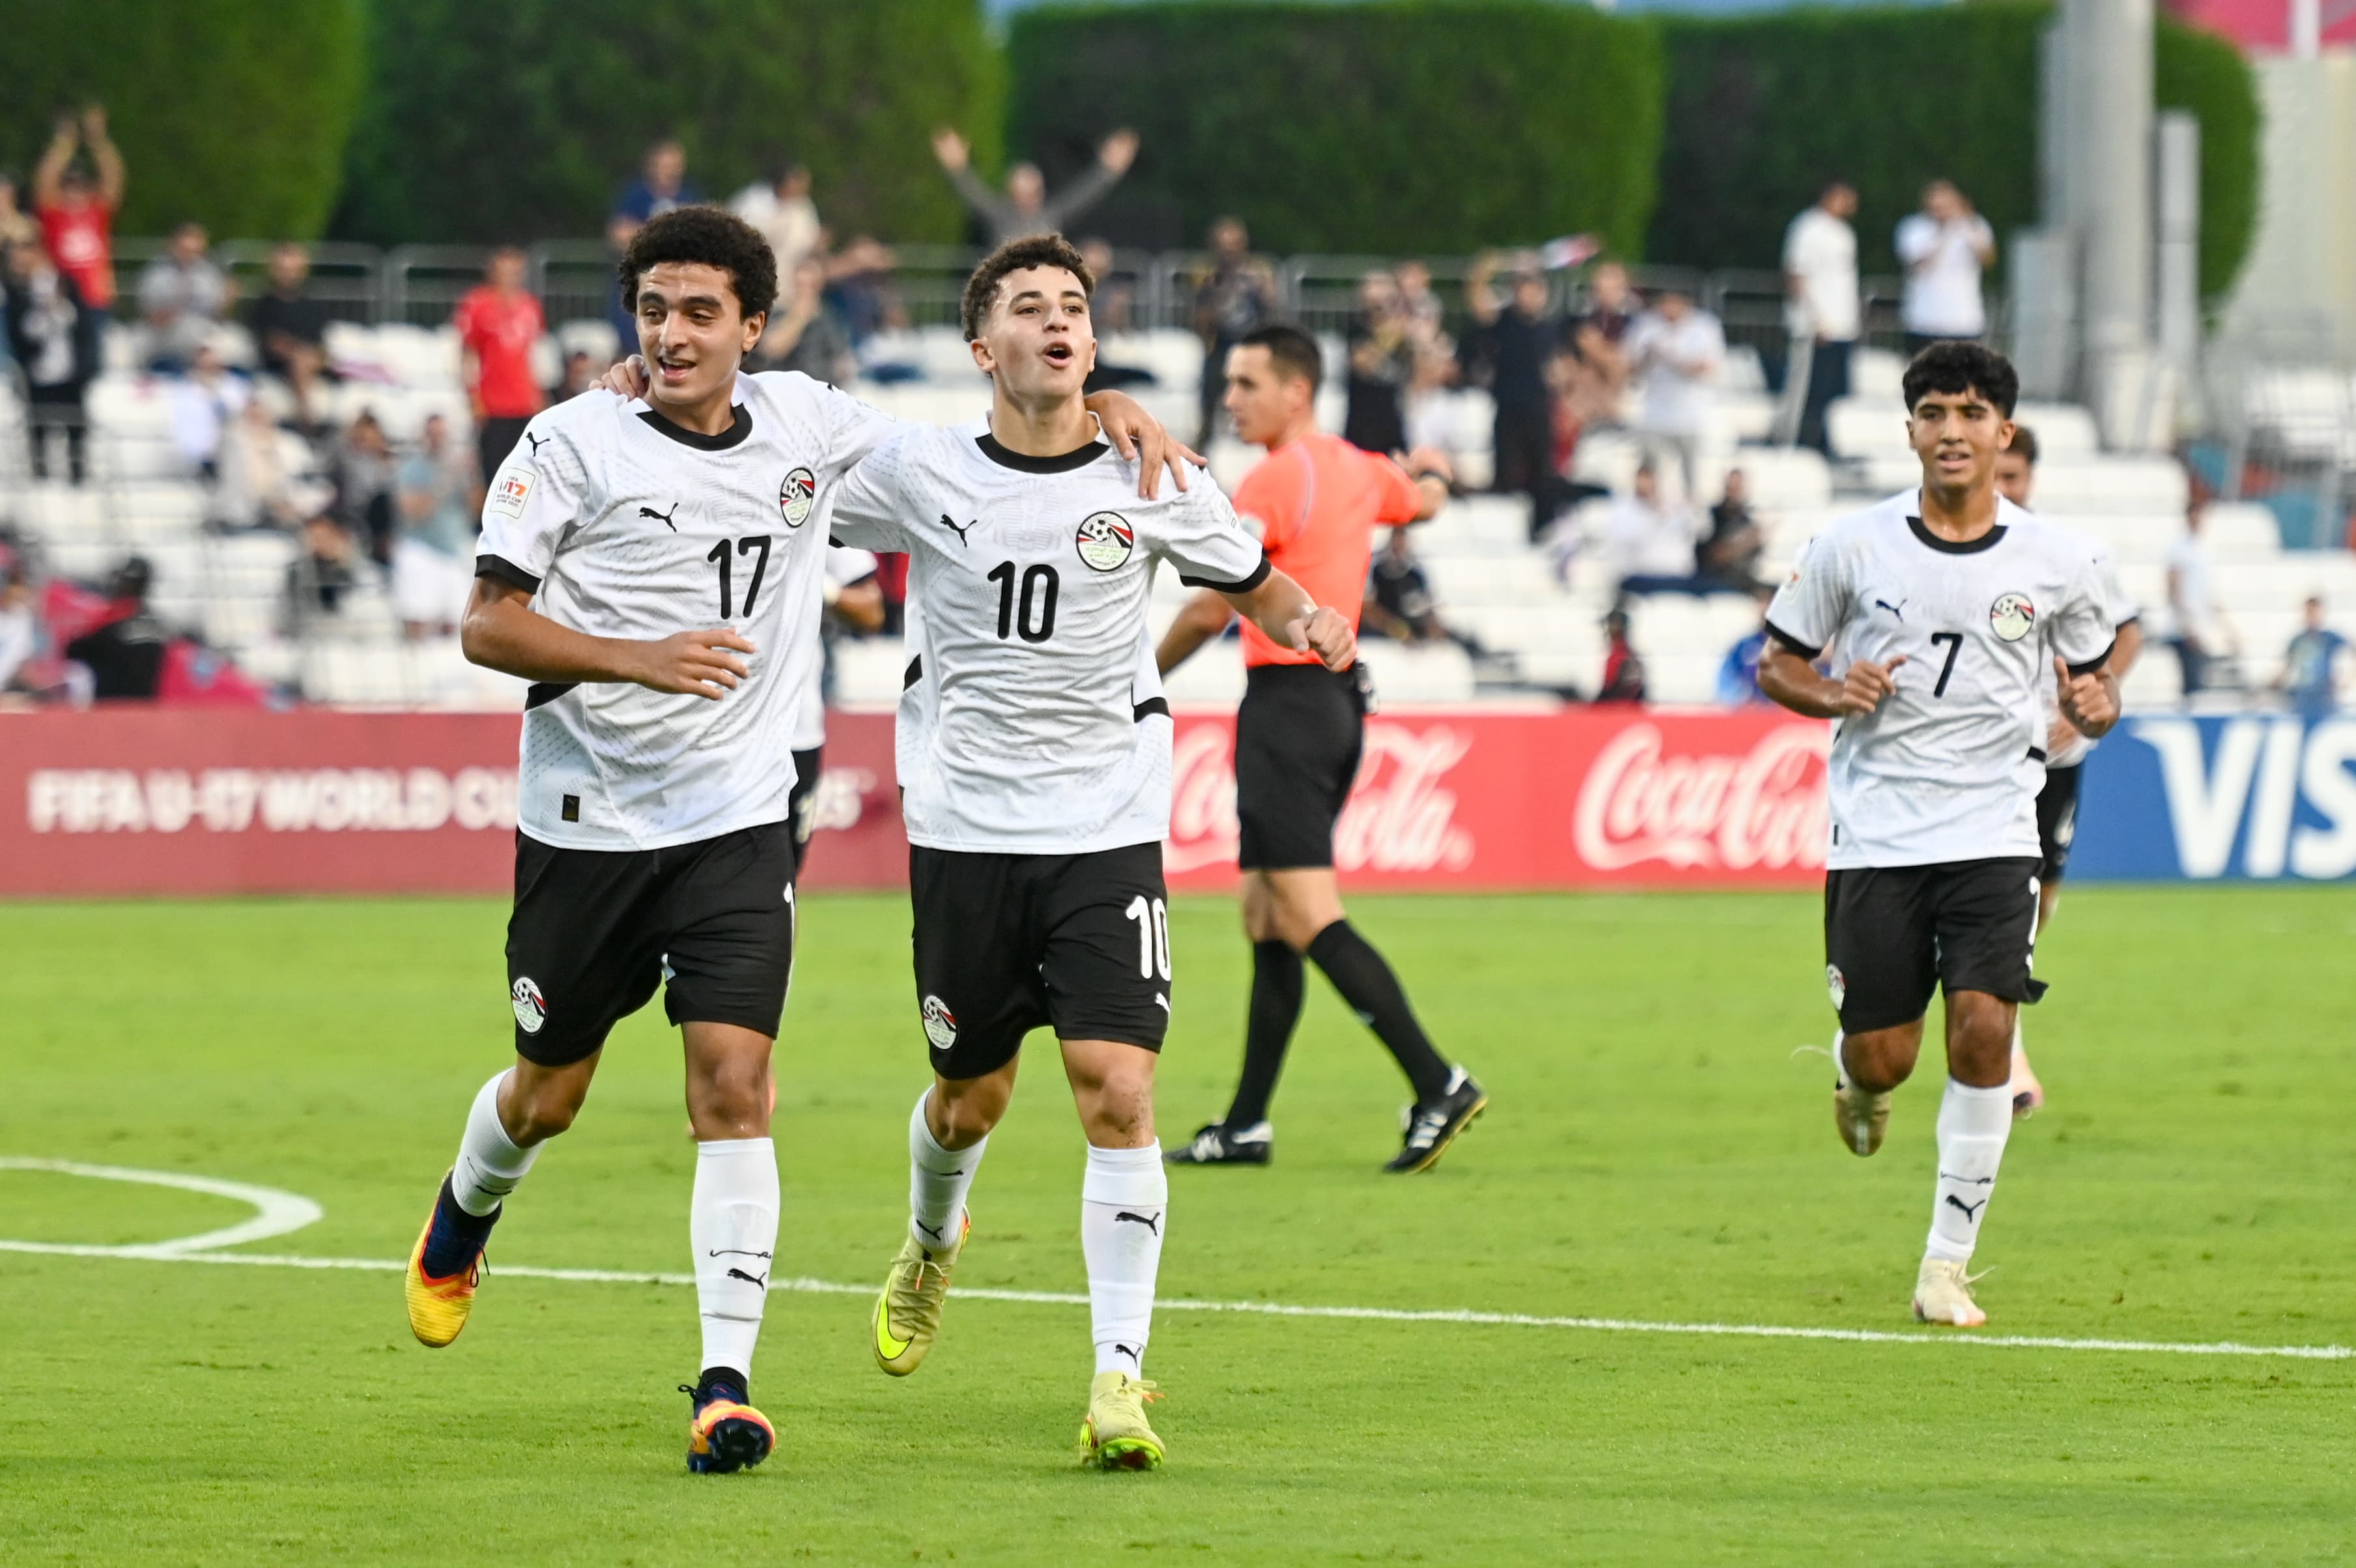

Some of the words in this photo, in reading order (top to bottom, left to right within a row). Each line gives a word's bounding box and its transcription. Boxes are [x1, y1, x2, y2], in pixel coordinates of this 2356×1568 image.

[707, 535, 771, 620] 17
[987, 560, 1060, 644] 10
[1931, 632, 1964, 699] 7
[28, 767, 145, 834] FIFA
[145, 767, 261, 833] U-17
[259, 766, 455, 832] WORLD
[455, 765, 520, 831] CU
[1126, 895, 1172, 982] 10
